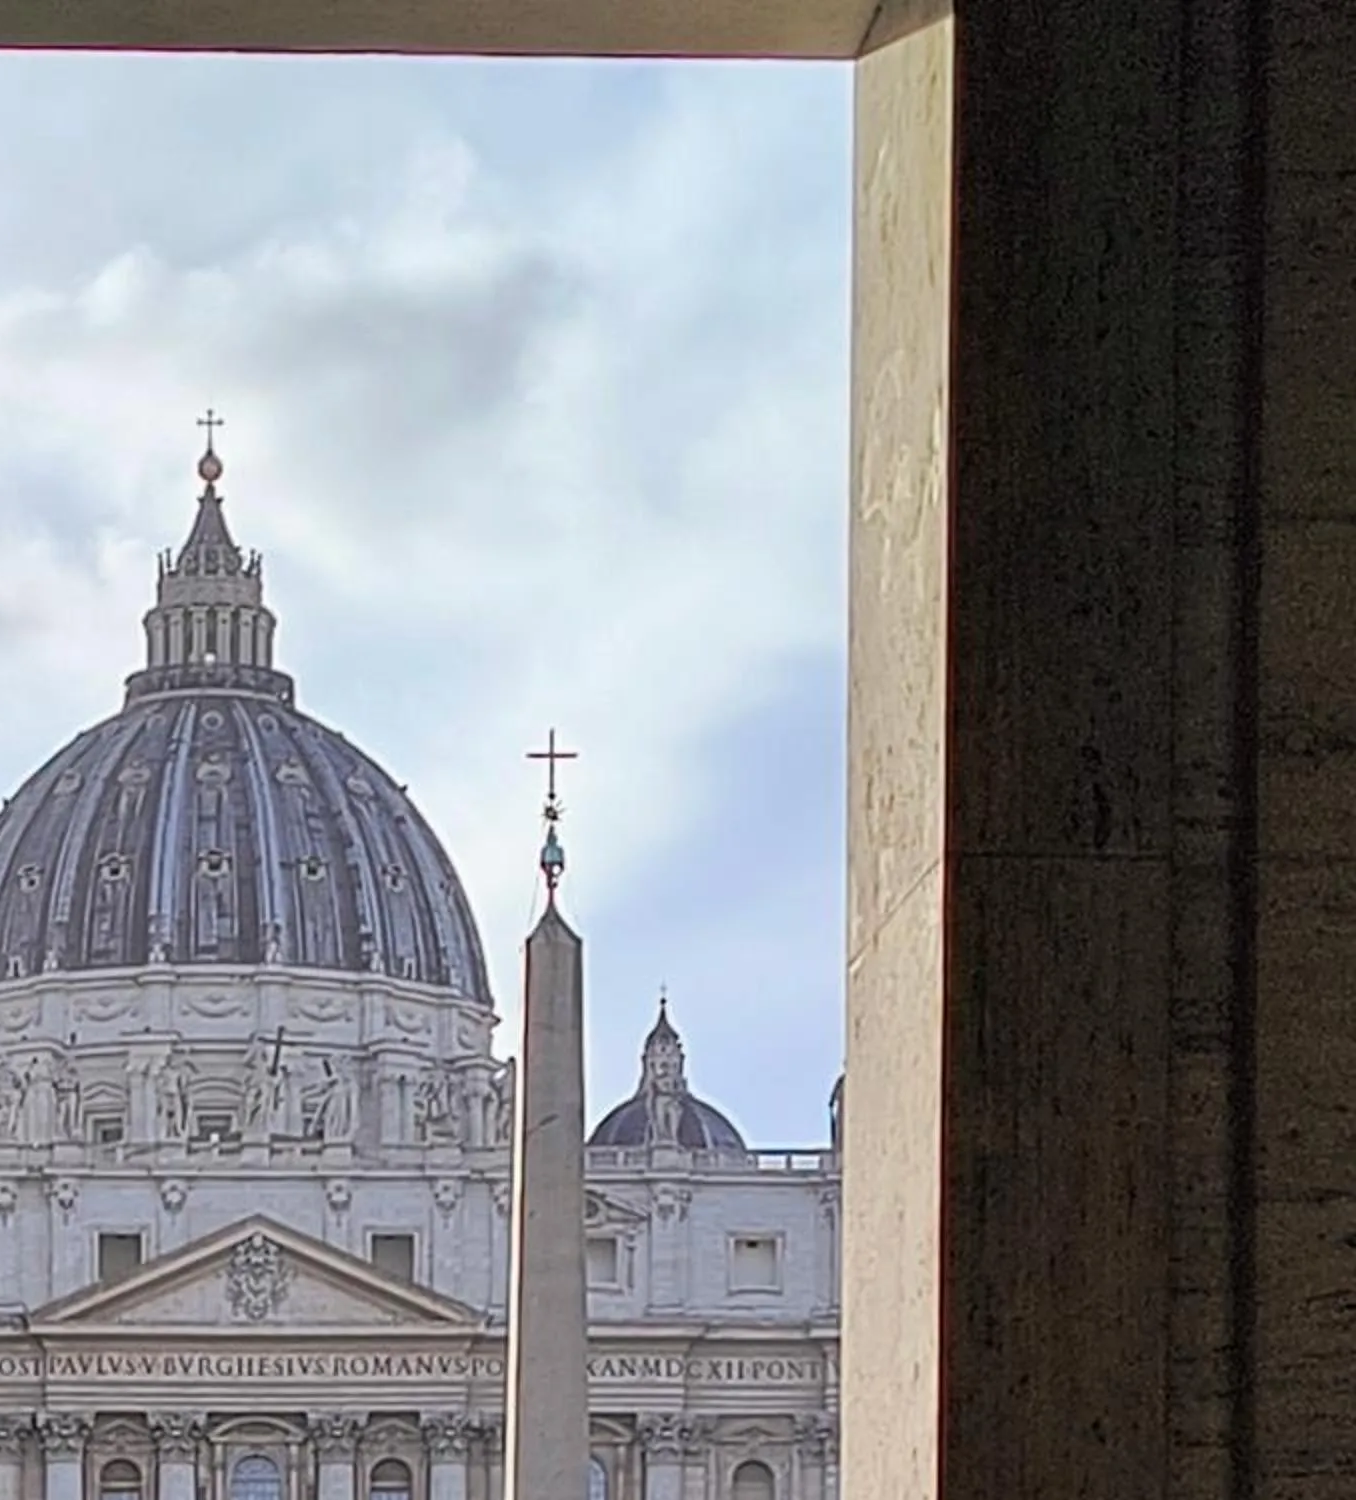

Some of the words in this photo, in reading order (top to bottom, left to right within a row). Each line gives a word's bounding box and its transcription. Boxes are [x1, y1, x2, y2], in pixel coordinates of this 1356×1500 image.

[48, 1355, 137, 1377] PAVLVS
[141, 1356, 158, 1376] V
[163, 1355, 326, 1378] BVRGHESIVS
[332, 1355, 469, 1377] ROMANVS
[751, 1359, 820, 1381] PONT
